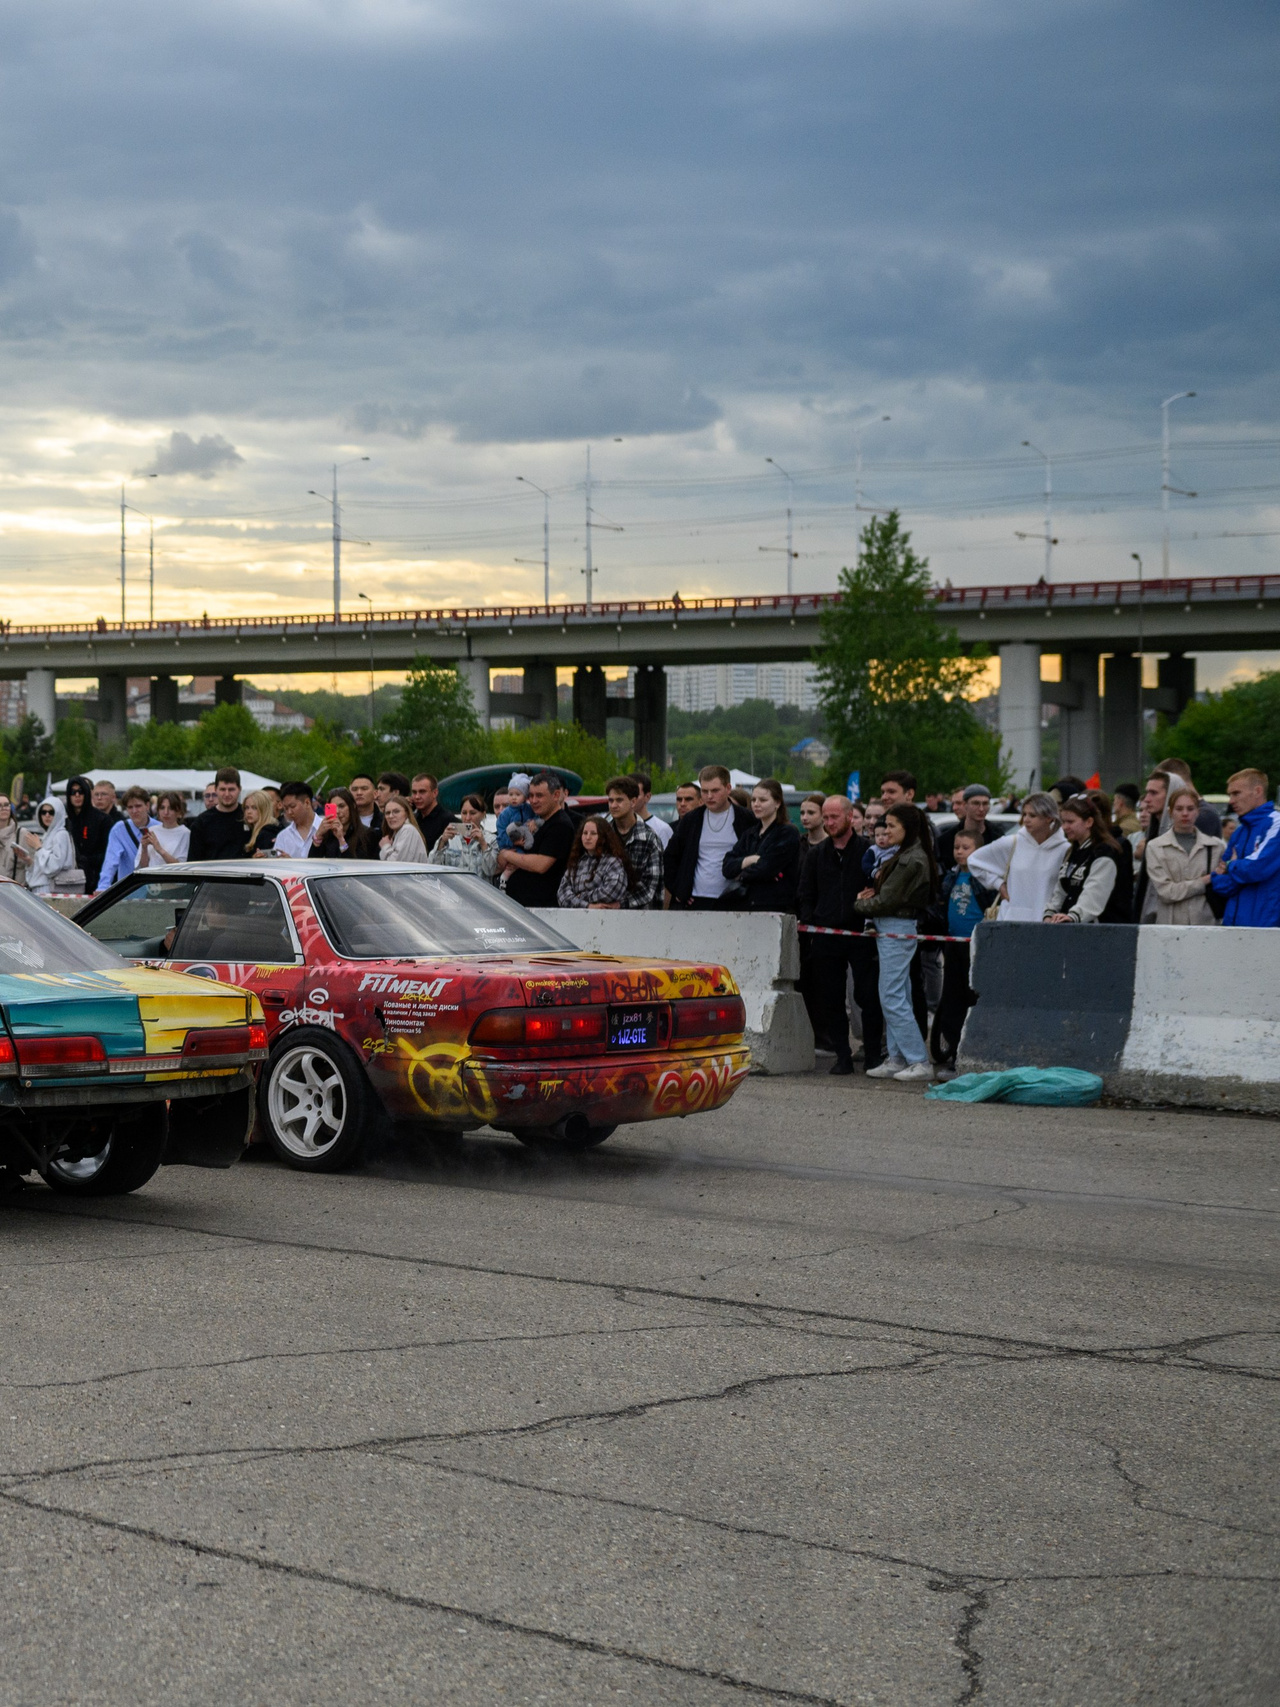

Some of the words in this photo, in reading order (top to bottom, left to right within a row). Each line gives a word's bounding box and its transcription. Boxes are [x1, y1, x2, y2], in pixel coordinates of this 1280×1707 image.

[383, 1000, 412, 1009] Кованые
[438, 1004, 459, 1012] диски
[390, 1026, 415, 1034] Советская
[617, 1027, 647, 1045] 1JZ-GTE
